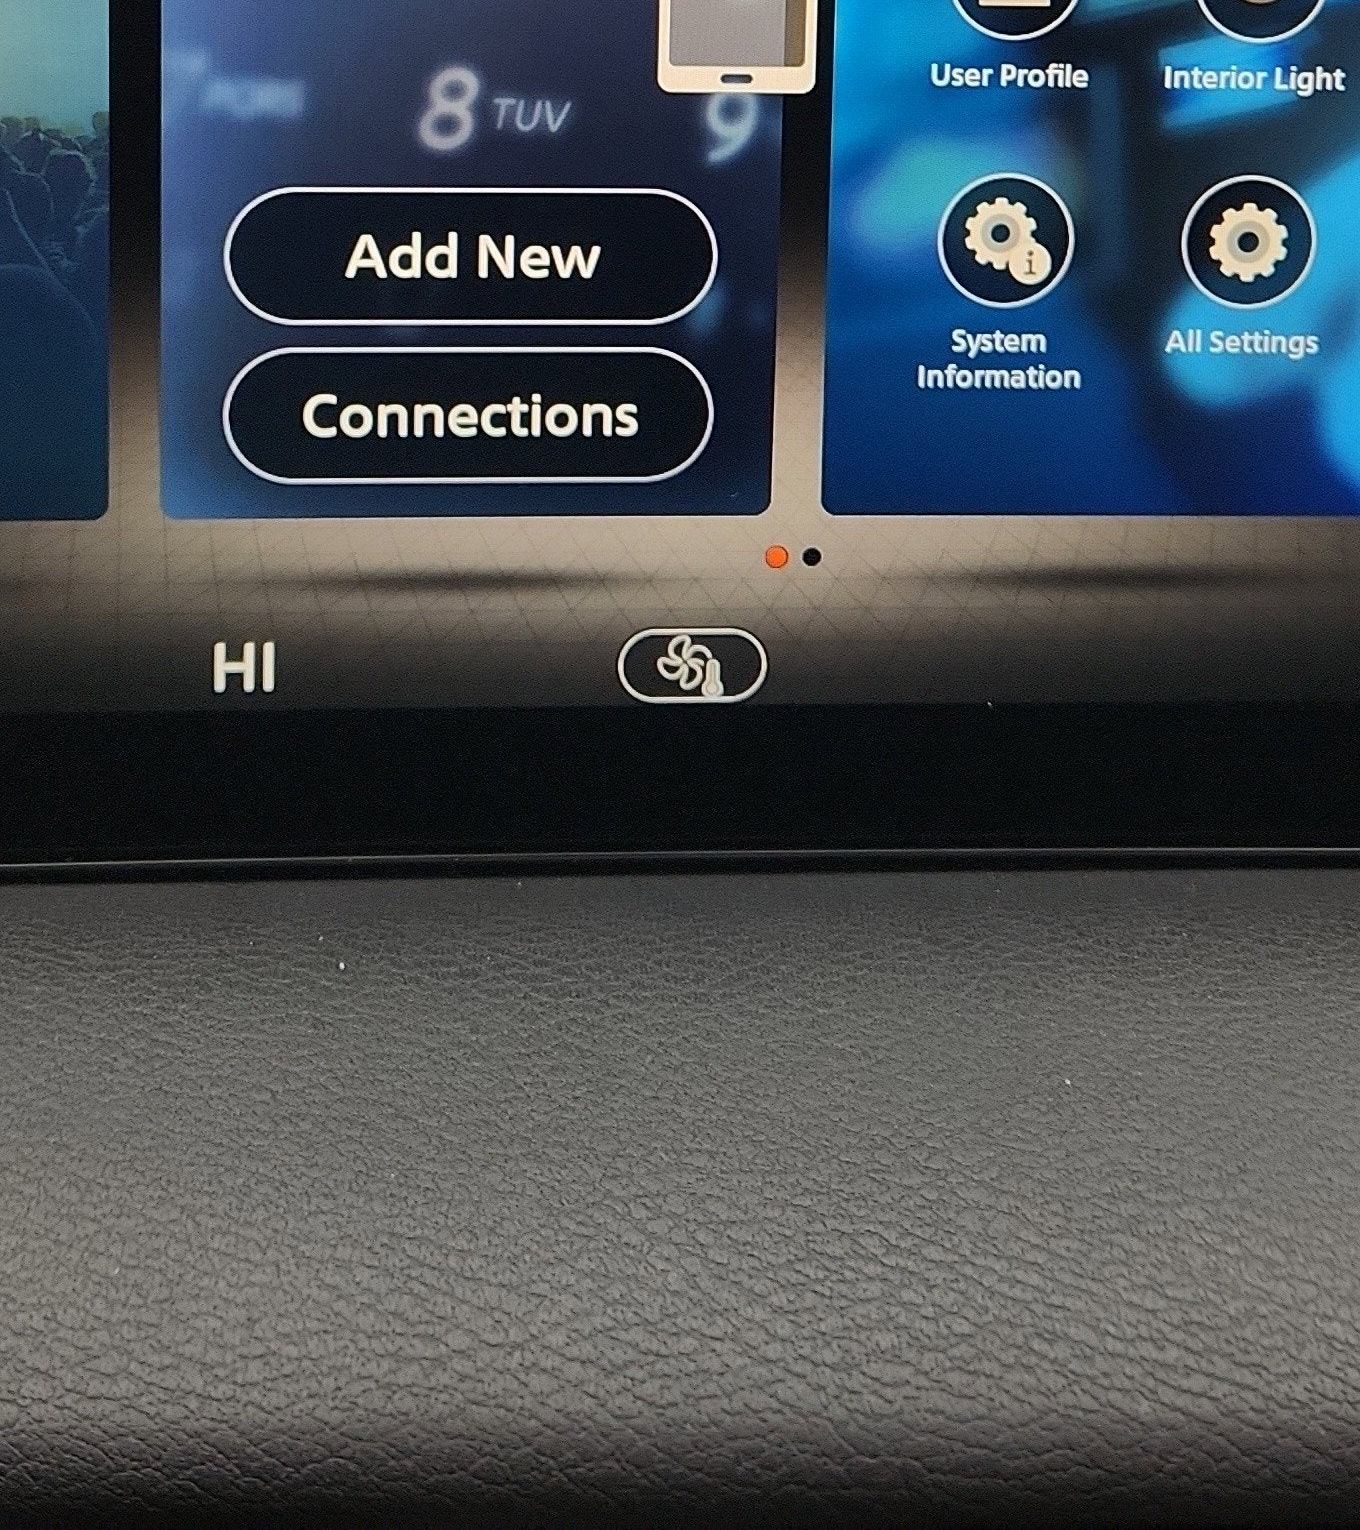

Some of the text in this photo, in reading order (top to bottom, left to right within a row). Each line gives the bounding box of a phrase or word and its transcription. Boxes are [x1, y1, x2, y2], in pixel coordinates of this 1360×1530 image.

[930, 61, 1090, 89] User Profile
[1163, 64, 1347, 98] Interior Light
[417, 66, 573, 152] 8 TUV
[705, 92, 760, 164] 9
[343, 230, 603, 280] Add New
[950, 327, 1048, 359] System
[1163, 328, 1319, 361] All Settings
[916, 362, 1082, 391] Information
[301, 392, 640, 440] Connections
[212, 640, 276, 694] HI
